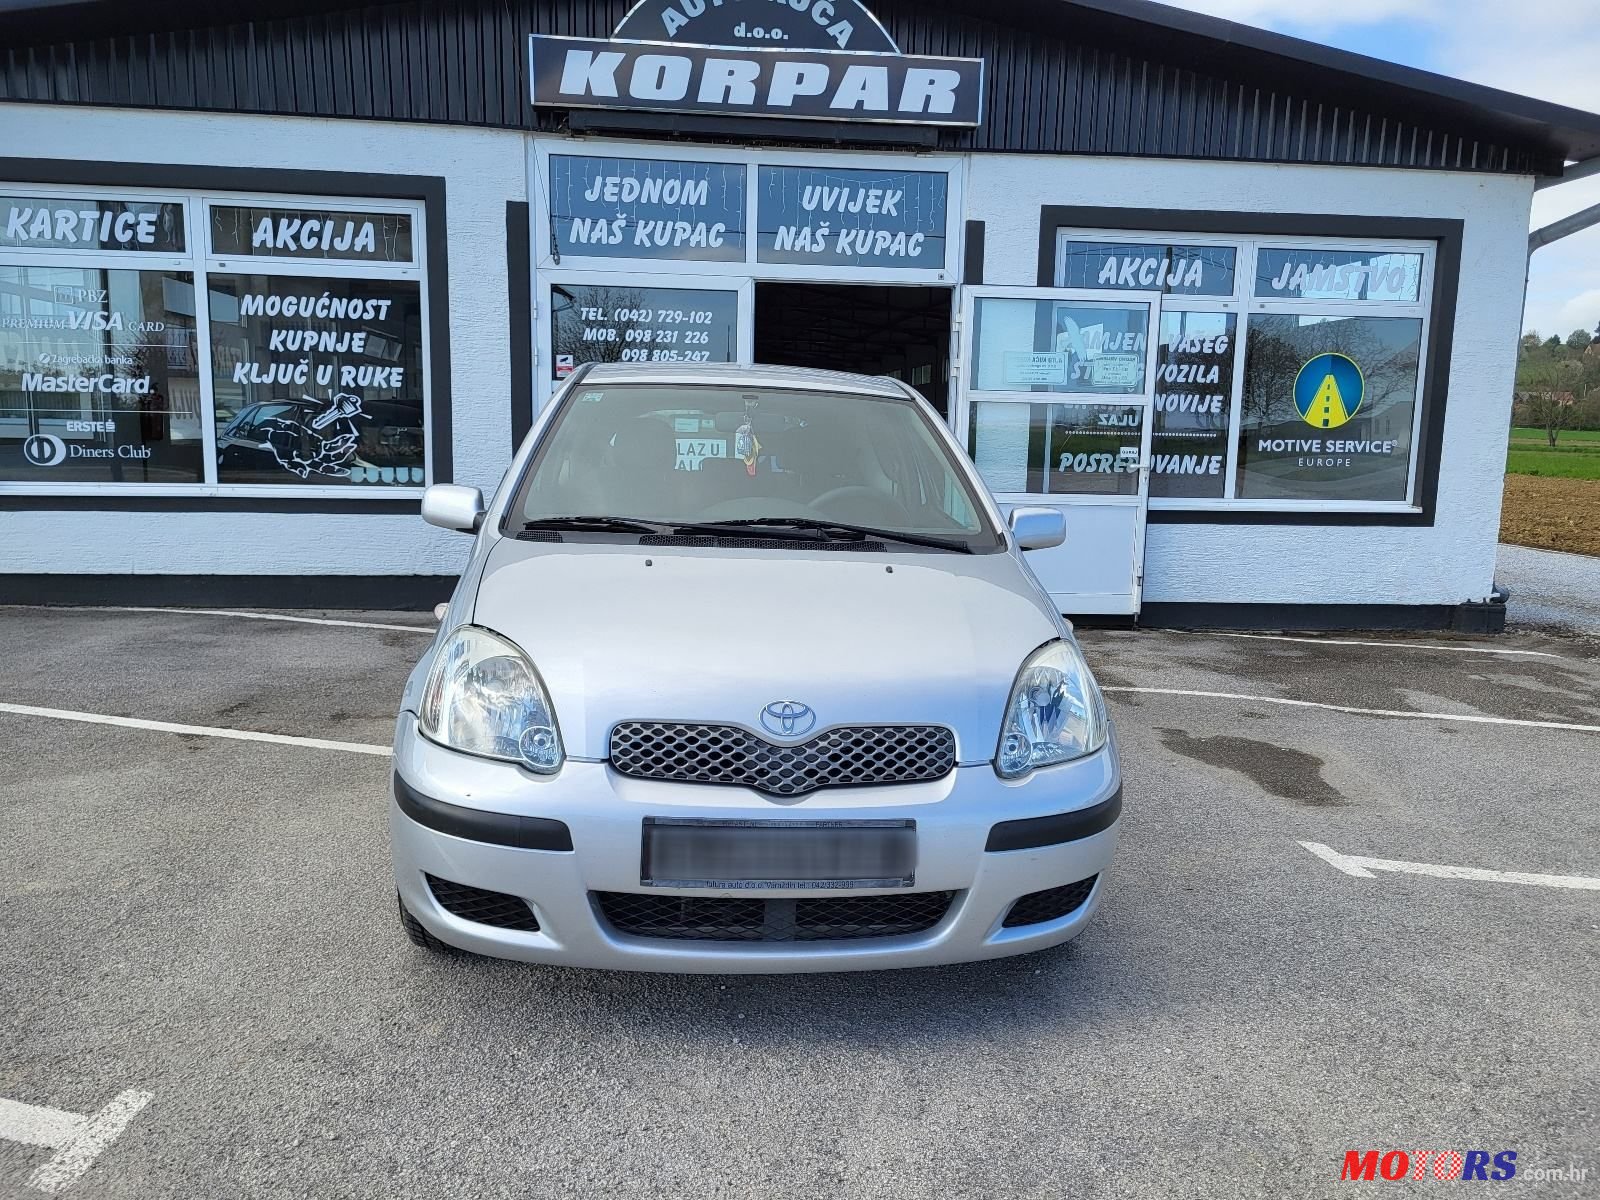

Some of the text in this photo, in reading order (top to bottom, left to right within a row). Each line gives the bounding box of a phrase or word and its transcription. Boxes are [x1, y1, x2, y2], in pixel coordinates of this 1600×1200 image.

[661, 0, 742, 38] AU
[733, 22, 789, 40] d.o.o.
[559, 49, 961, 114] KORPAR
[584, 175, 708, 206] JEDNOM
[801, 185, 903, 217] UVIJEK
[6, 207, 157, 243] KARTICE
[252, 217, 376, 253] AKCIJA
[569, 213, 726, 248] NAŠ KUPAC
[774, 221, 925, 257] NAŠ KUPAC
[1098, 256, 1203, 287] AKCIJA
[1271, 263, 1407, 293] JAMSTVO
[78, 289, 109, 303] PBZ
[240, 291, 391, 320] MOGUĆNOST
[2, 311, 165, 332] PREMIUM VISA CARD
[580, 307, 713, 324] TEL. (042) 729-102
[269, 329, 367, 353] KUPNJE
[582, 328, 709, 344] MOB. 098 231 226
[105, 354, 133, 365] banka
[622, 348, 711, 363] 098 805-247
[233, 359, 404, 388] KLJUČ U RUKE
[66, 421, 105, 432] ERSTE
[70, 444, 151, 459] Diners Club
[711, 443, 720, 457] U
[1258, 440, 1321, 452] MOTIVE
[1298, 458, 1351, 467] EUROPE
